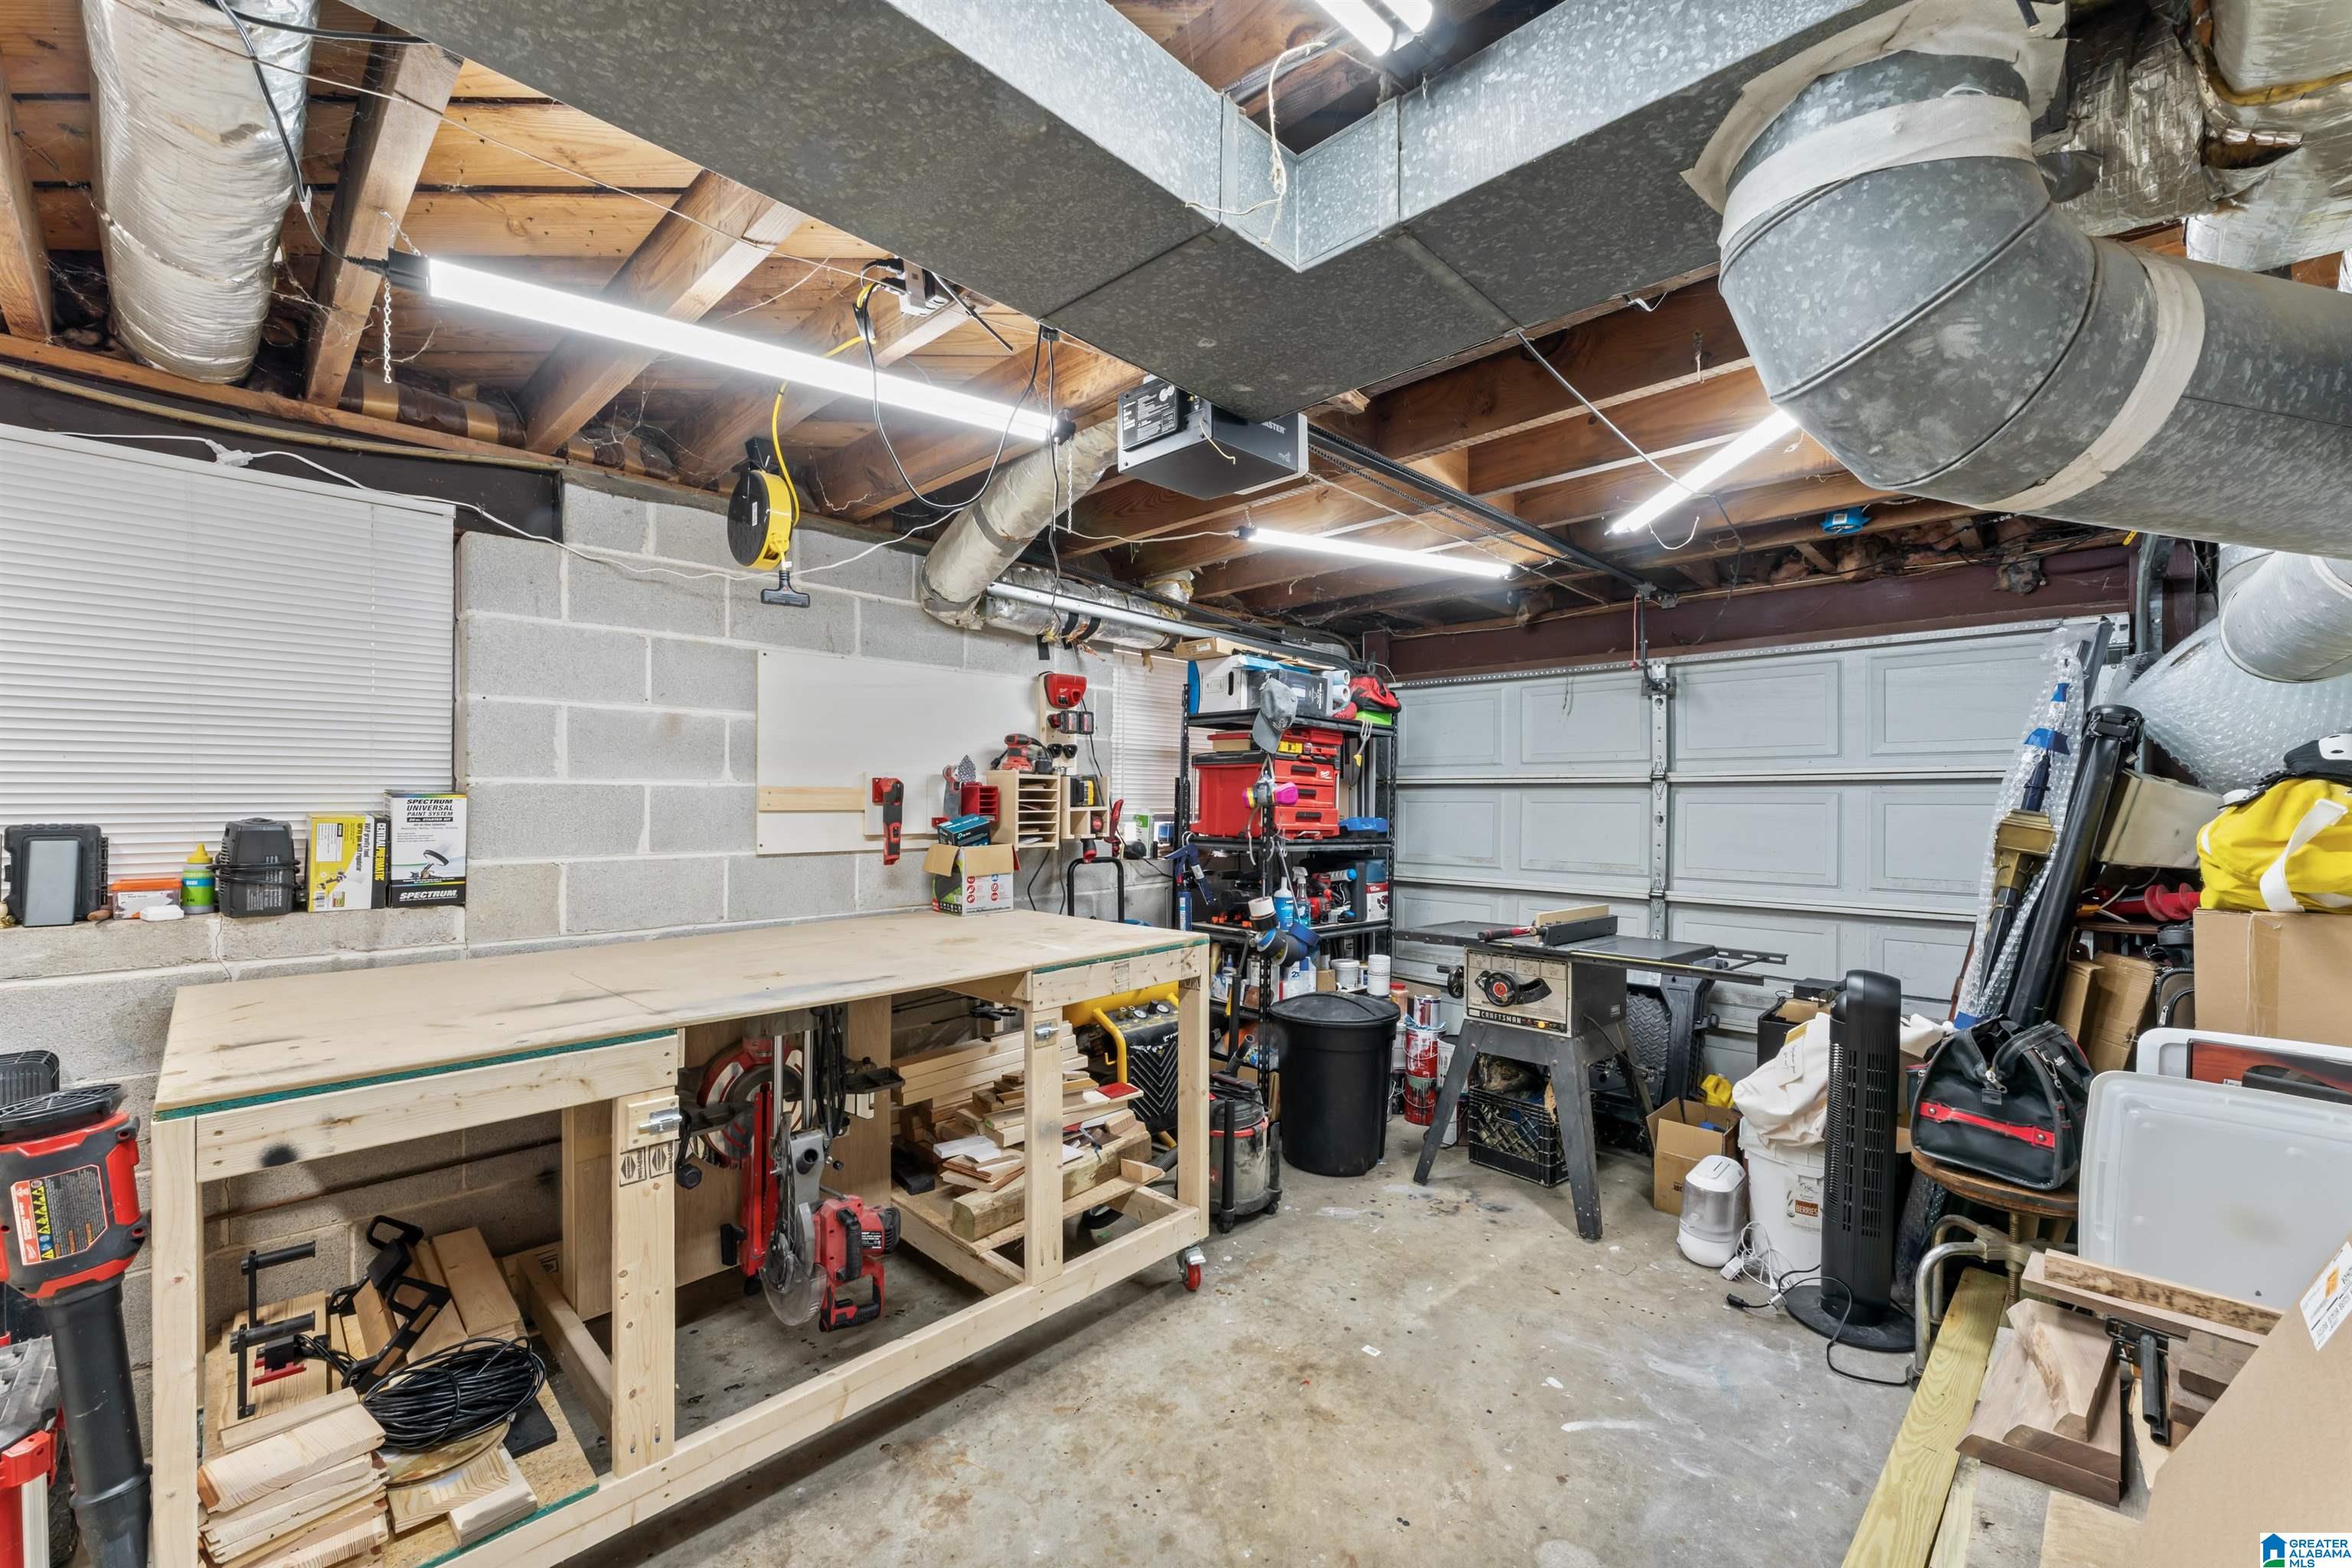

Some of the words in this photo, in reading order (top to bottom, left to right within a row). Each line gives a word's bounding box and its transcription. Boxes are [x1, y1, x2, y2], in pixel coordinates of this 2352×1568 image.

[399, 890, 458, 899] SPECTRUM
[1481, 1011, 1521, 1024] CRAFTSMAN
[1795, 1204, 1818, 1214] BERRIES
